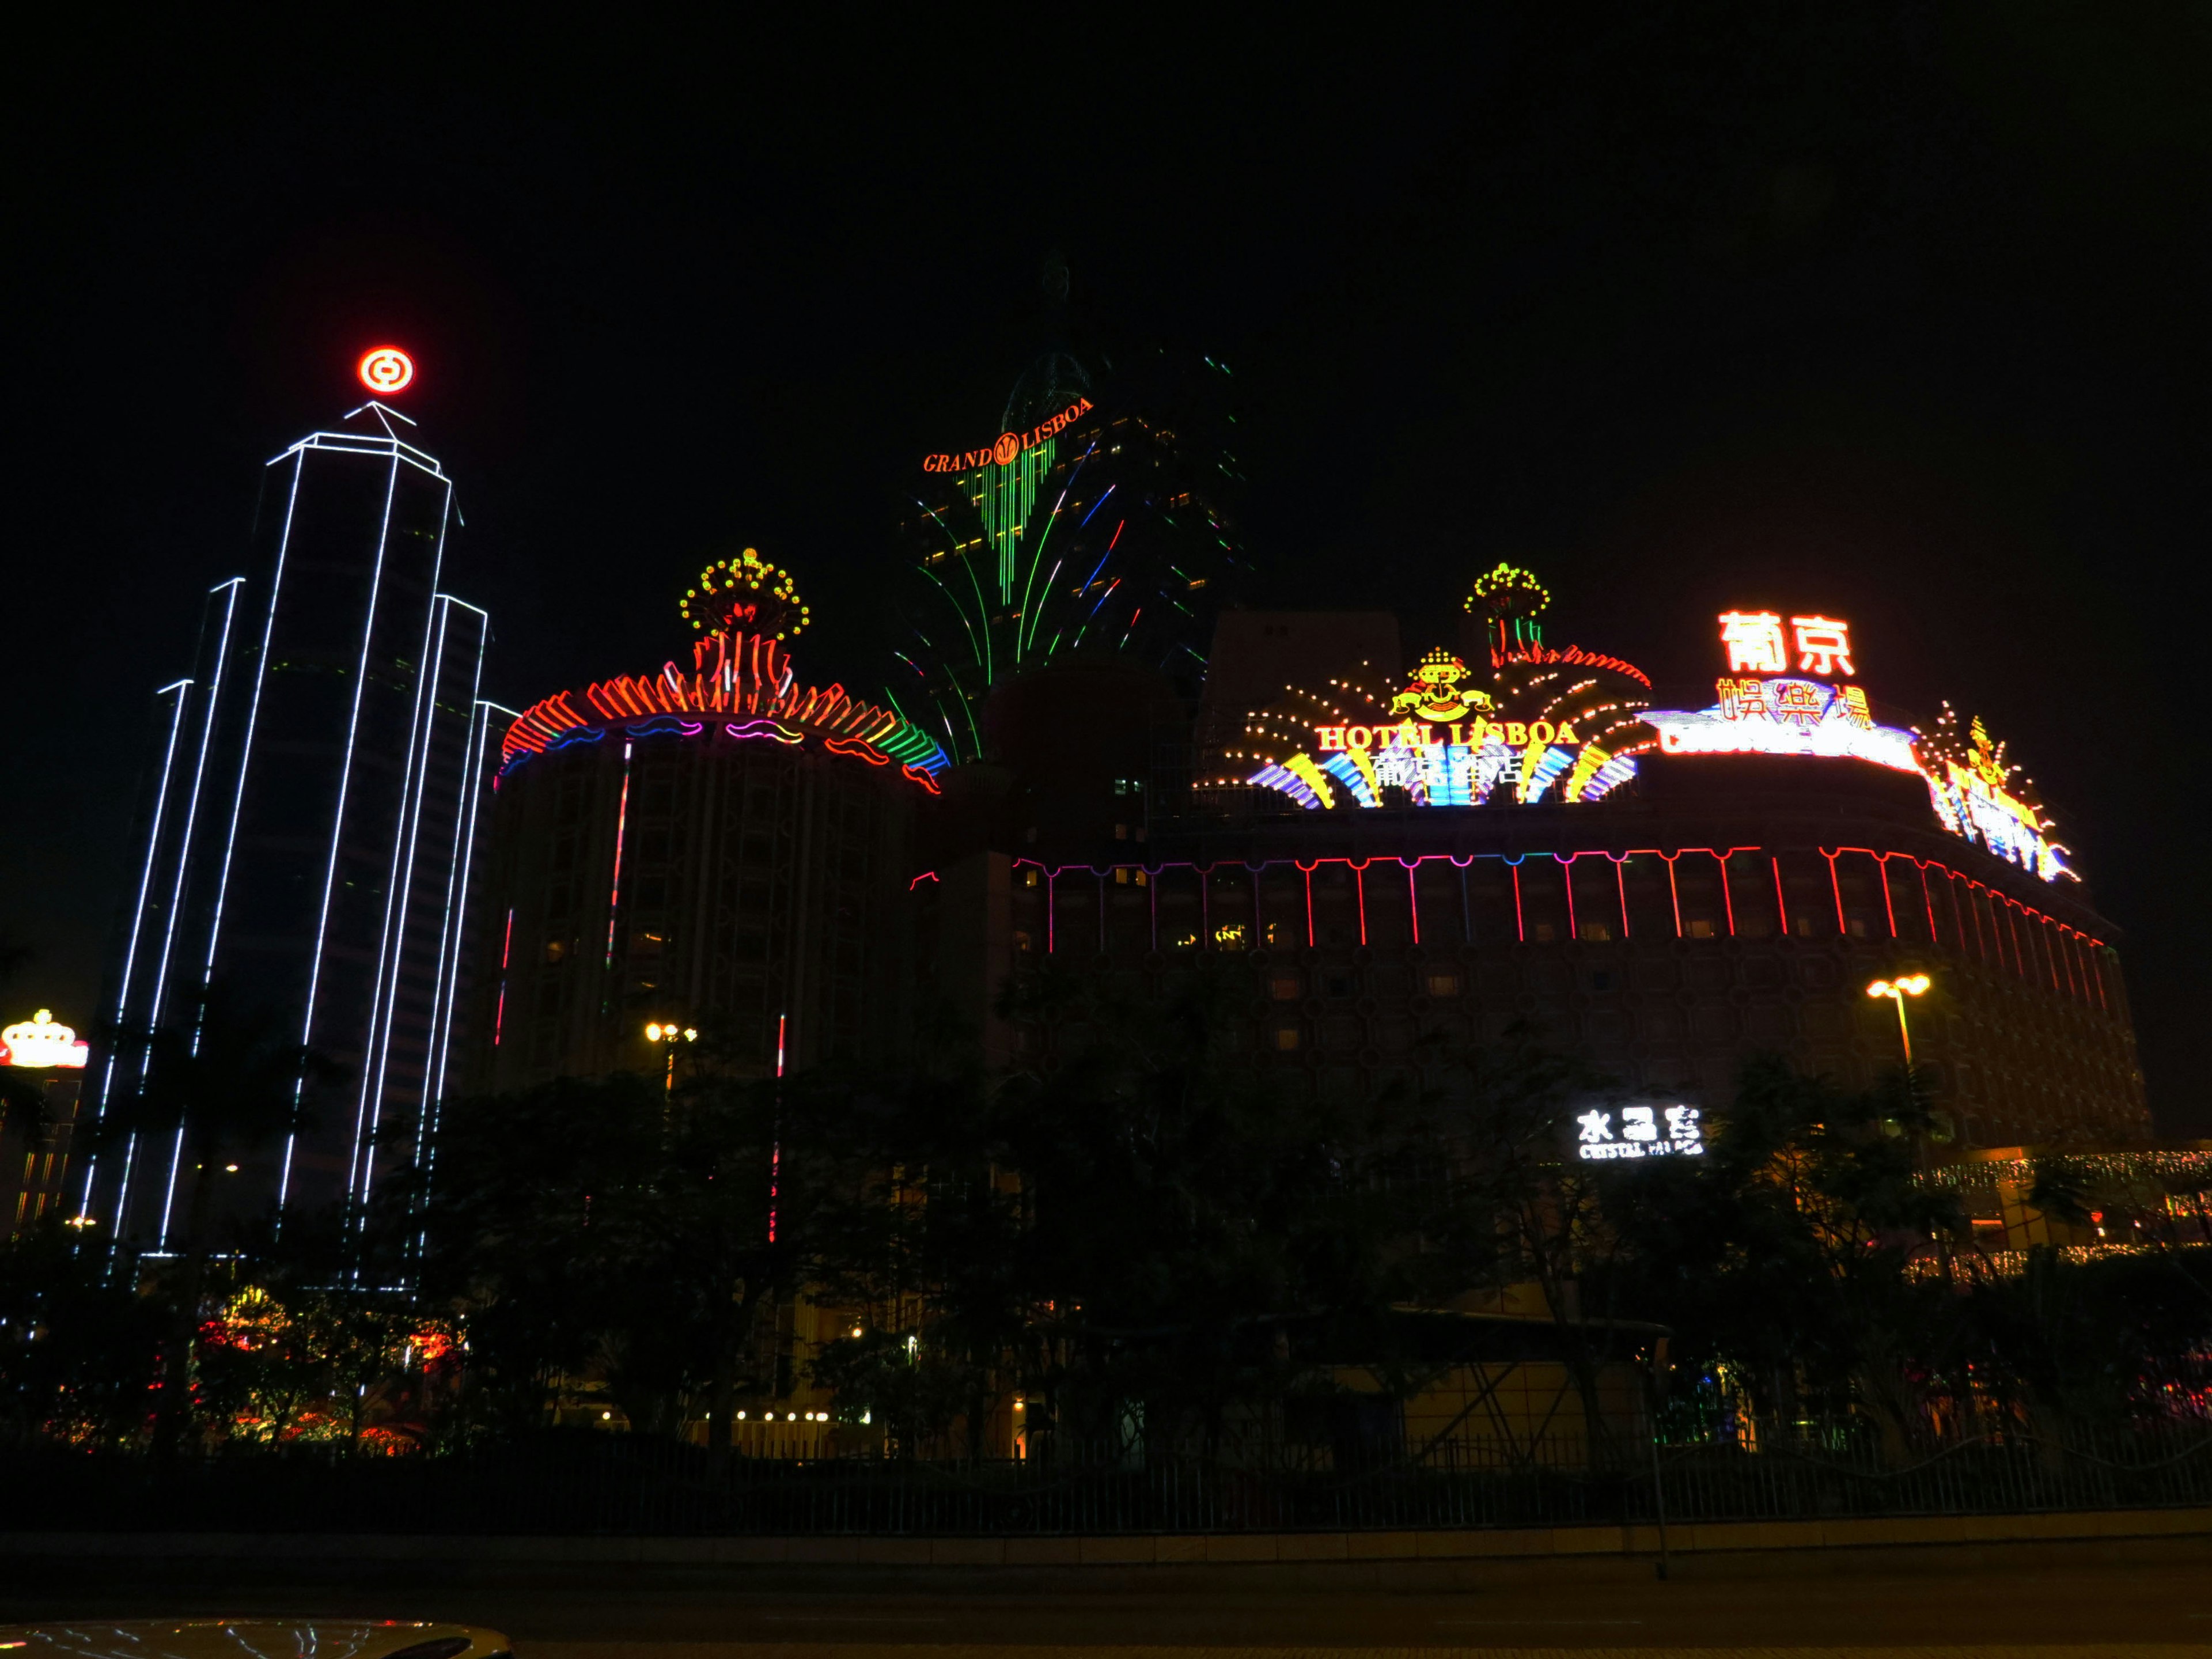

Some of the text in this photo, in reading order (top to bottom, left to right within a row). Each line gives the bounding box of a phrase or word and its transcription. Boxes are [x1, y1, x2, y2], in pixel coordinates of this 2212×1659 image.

[923, 397, 1094, 472] GRAND LISBOA
[1718, 610, 1855, 675] 葡京
[1314, 721, 1580, 751] HOTEL LISBOA
